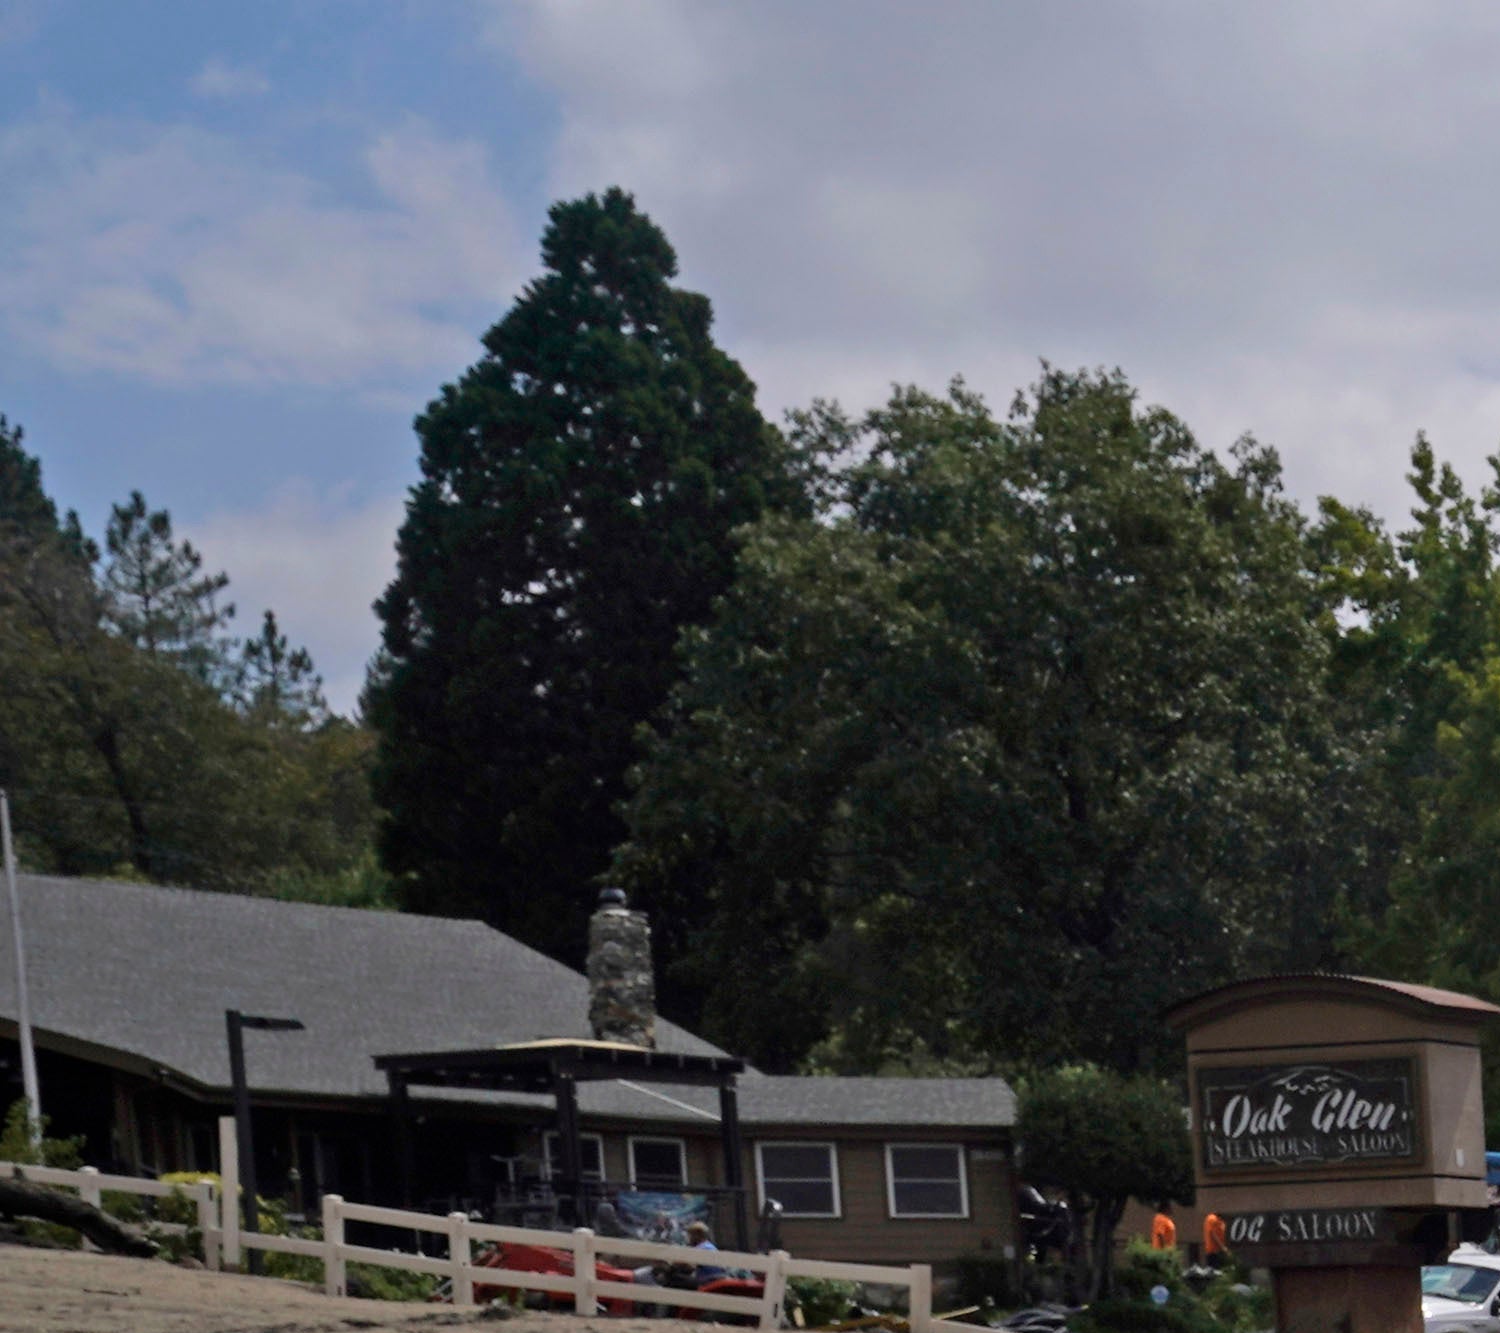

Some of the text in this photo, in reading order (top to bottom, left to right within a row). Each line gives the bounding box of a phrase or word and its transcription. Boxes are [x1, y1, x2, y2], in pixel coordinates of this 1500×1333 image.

[1222, 1089, 1396, 1138] Oak Glen
[1213, 1132, 1405, 1159] STEAKHOUSE SALOON
[1230, 1211, 1376, 1242] OG SALOON
